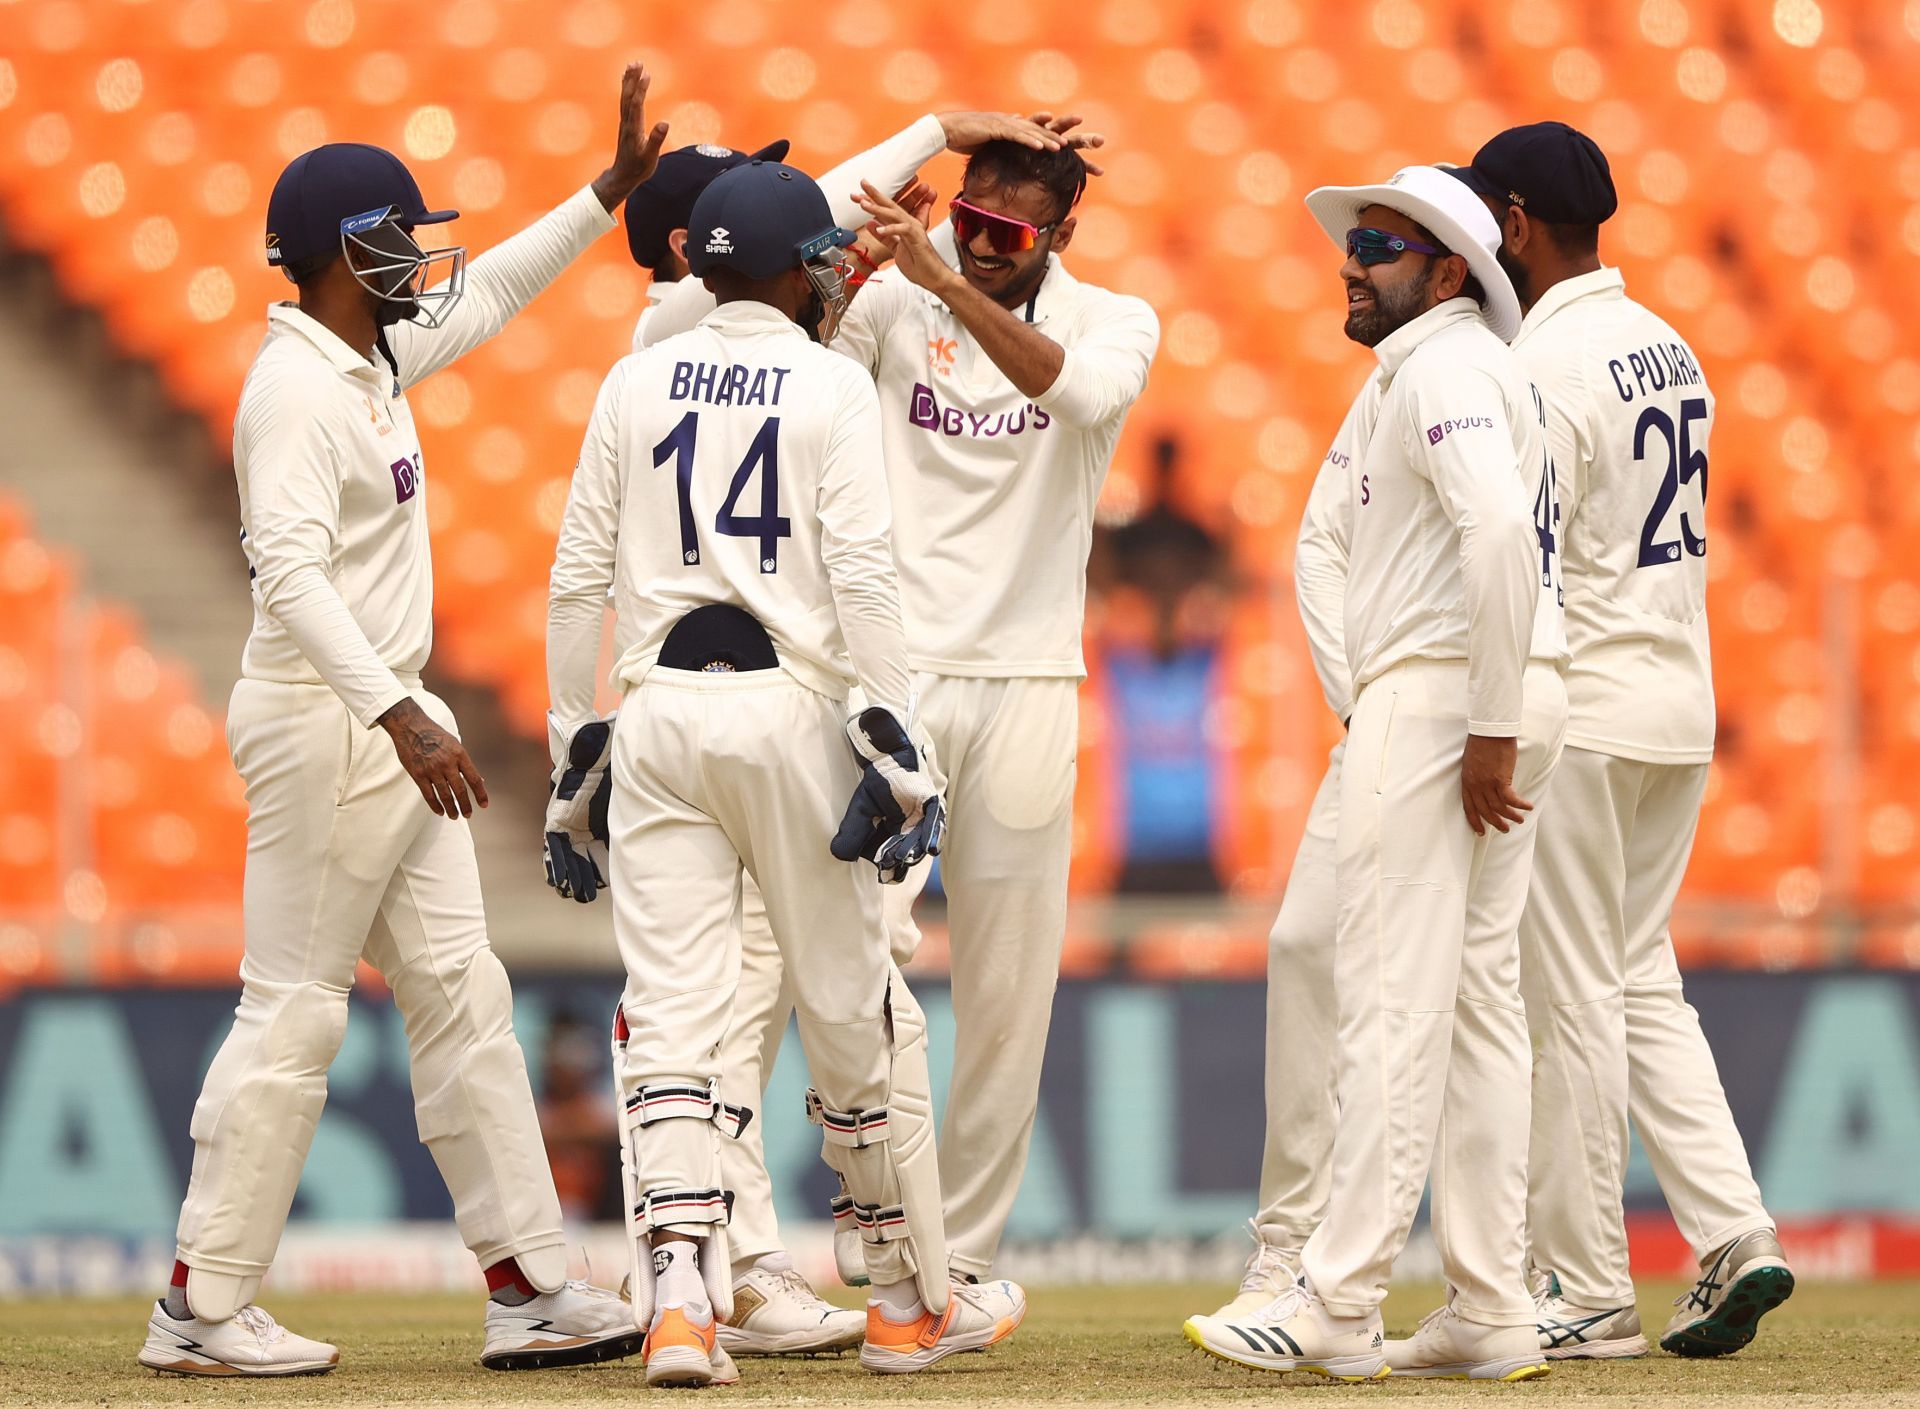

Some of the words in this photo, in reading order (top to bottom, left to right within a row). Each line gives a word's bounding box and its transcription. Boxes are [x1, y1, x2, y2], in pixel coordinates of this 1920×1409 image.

[1508, 190, 1525, 206] 266
[358, 214, 380, 225] FORMA
[705, 244, 735, 254] SHREY
[815, 236, 831, 251] AIR
[669, 361, 792, 407] BHARAT
[1608, 359, 1634, 402] C
[942, 403, 1050, 437] BYJU'S
[1444, 417, 1493, 434] BYJU'S
[652, 411, 792, 575] 14
[1633, 397, 1708, 569] 25
